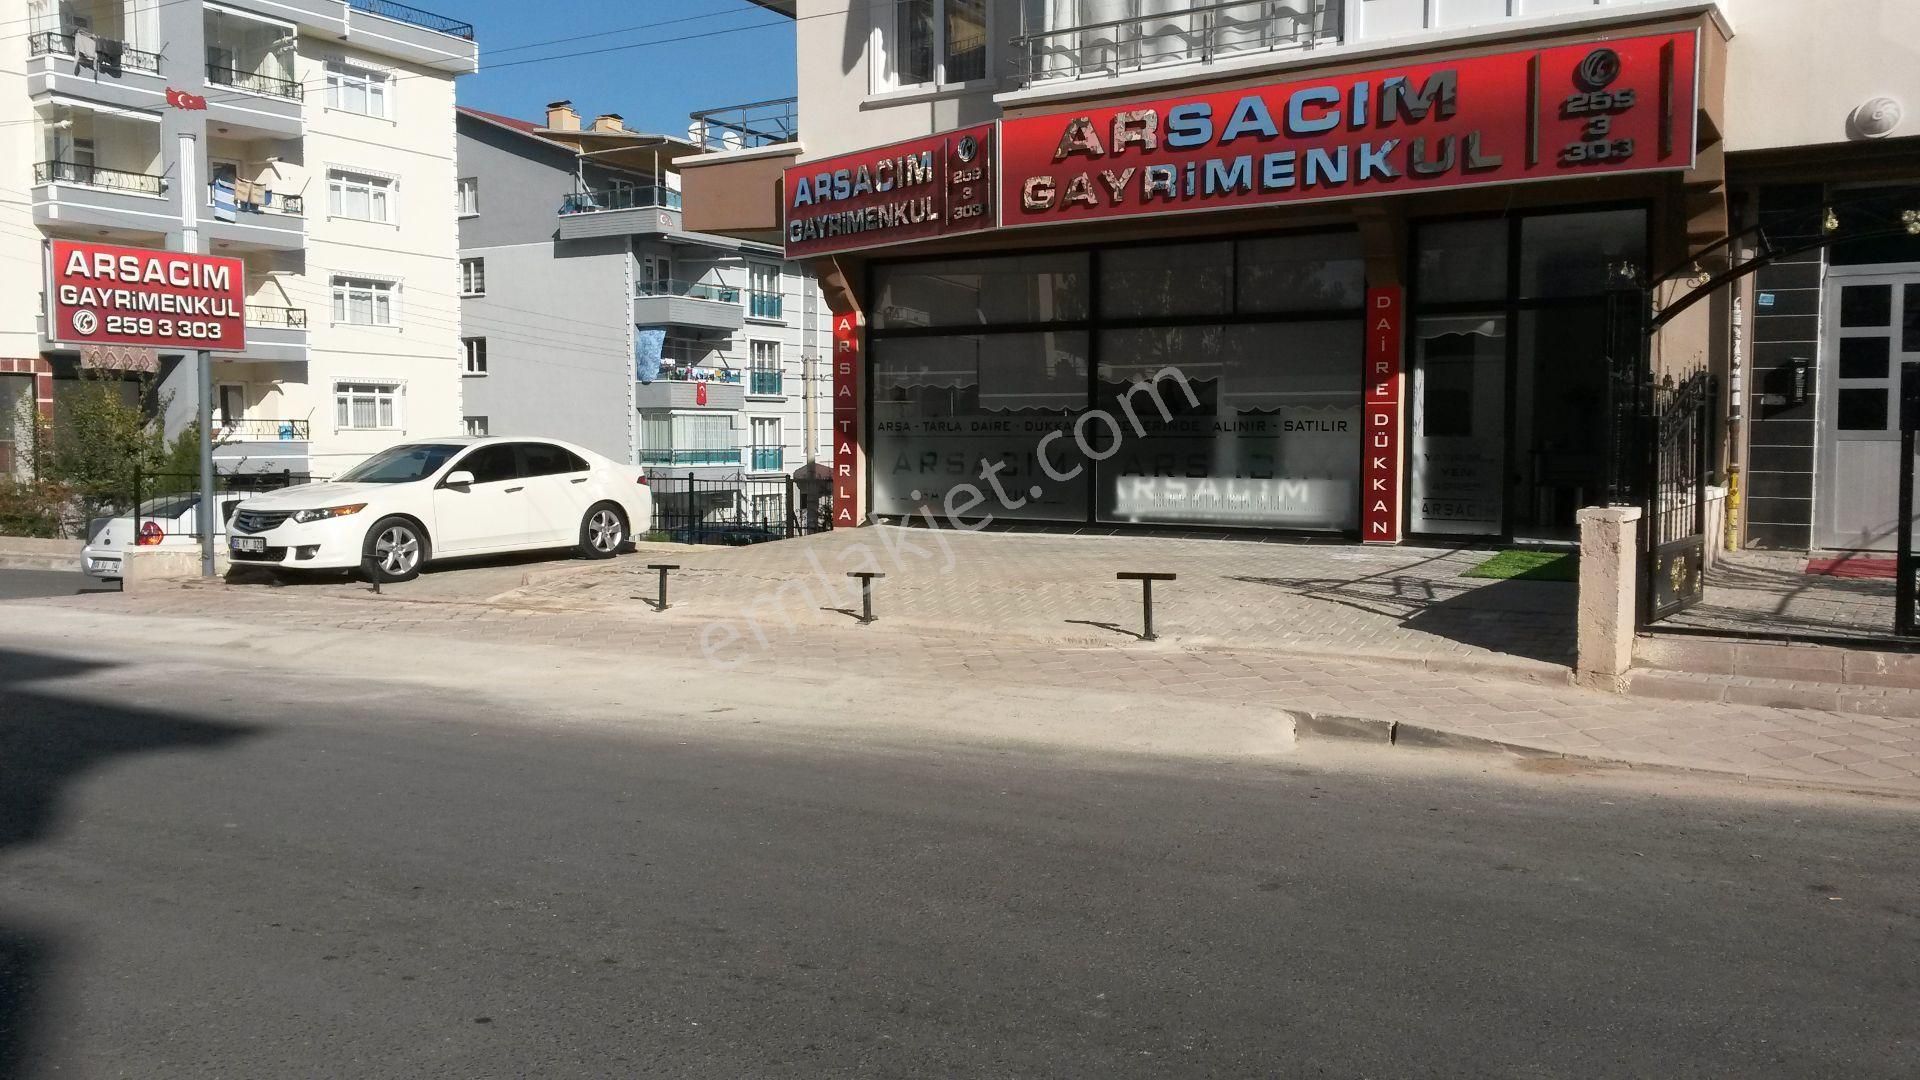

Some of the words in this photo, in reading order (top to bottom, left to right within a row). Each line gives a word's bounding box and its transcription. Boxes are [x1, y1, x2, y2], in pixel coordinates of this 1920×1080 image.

[1054, 69, 1457, 160] ARSACIM
[1589, 114, 1610, 135] 3
[1564, 138, 1634, 162] 303
[793, 150, 933, 208] ARSACIM
[963, 187, 973, 200] 3
[953, 203, 982, 220] 303
[64, 250, 231, 291] ARSACIM
[106, 315, 153, 335] 259
[158, 319, 173, 336] 3
[177, 321, 222, 340] 303
[838, 318, 851, 397] ARSA
[877, 421, 911, 432] ARSA
[922, 421, 962, 432] TARLA
[1212, 421, 1266, 432] ALINIR
[1284, 420, 1348, 432] SATILIR
[838, 420, 851, 521] TARLA
[1372, 413, 1389, 534] DÜKKAN
